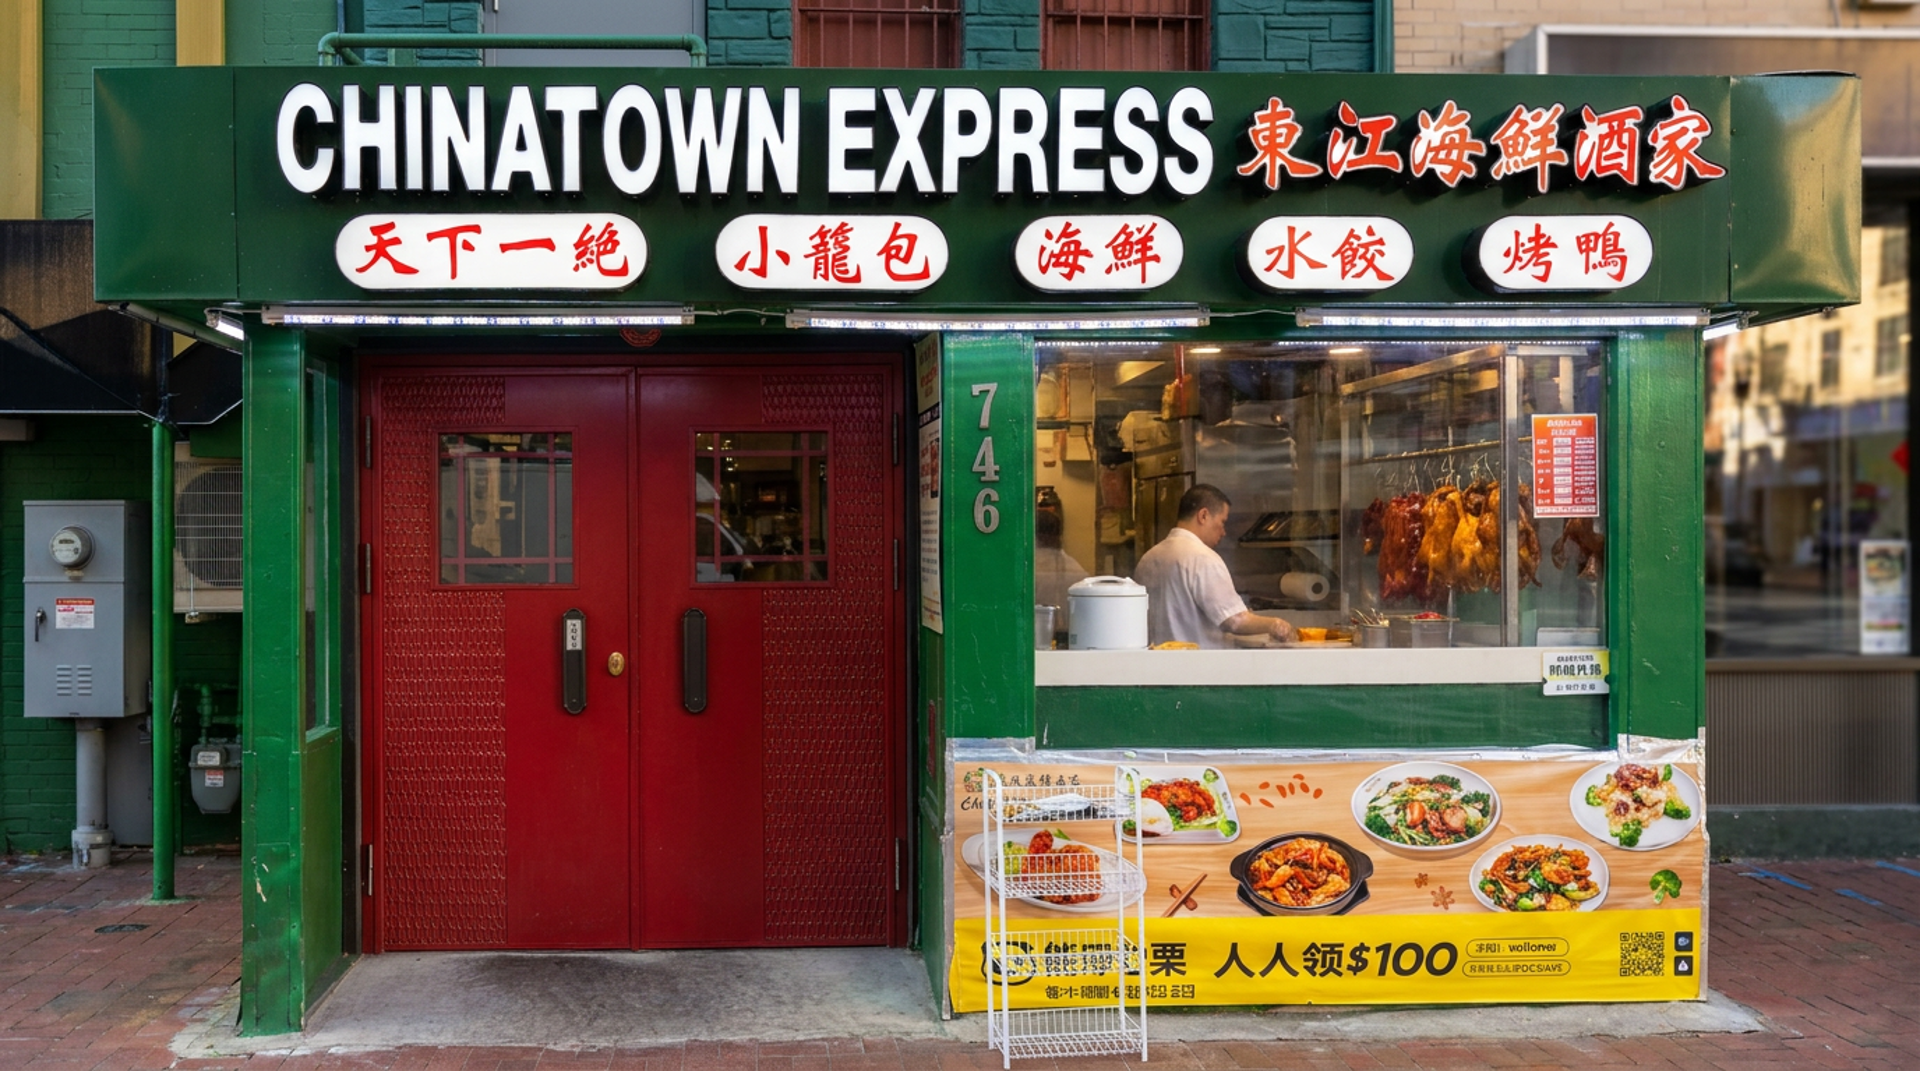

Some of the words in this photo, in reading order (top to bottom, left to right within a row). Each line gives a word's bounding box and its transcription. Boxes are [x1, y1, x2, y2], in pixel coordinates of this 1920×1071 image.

[276, 82, 801, 195] CHINATOWN
[827, 86, 1215, 195] EXPRESS
[1237, 94, 1727, 193] 東江海鮮酒家
[733, 221, 931, 284] 小籠包
[1037, 221, 1162, 284] 海鮮
[1263, 225, 1395, 282] 水餃
[1502, 221, 1629, 283] 烤鴨
[971, 383, 1000, 534] 746
